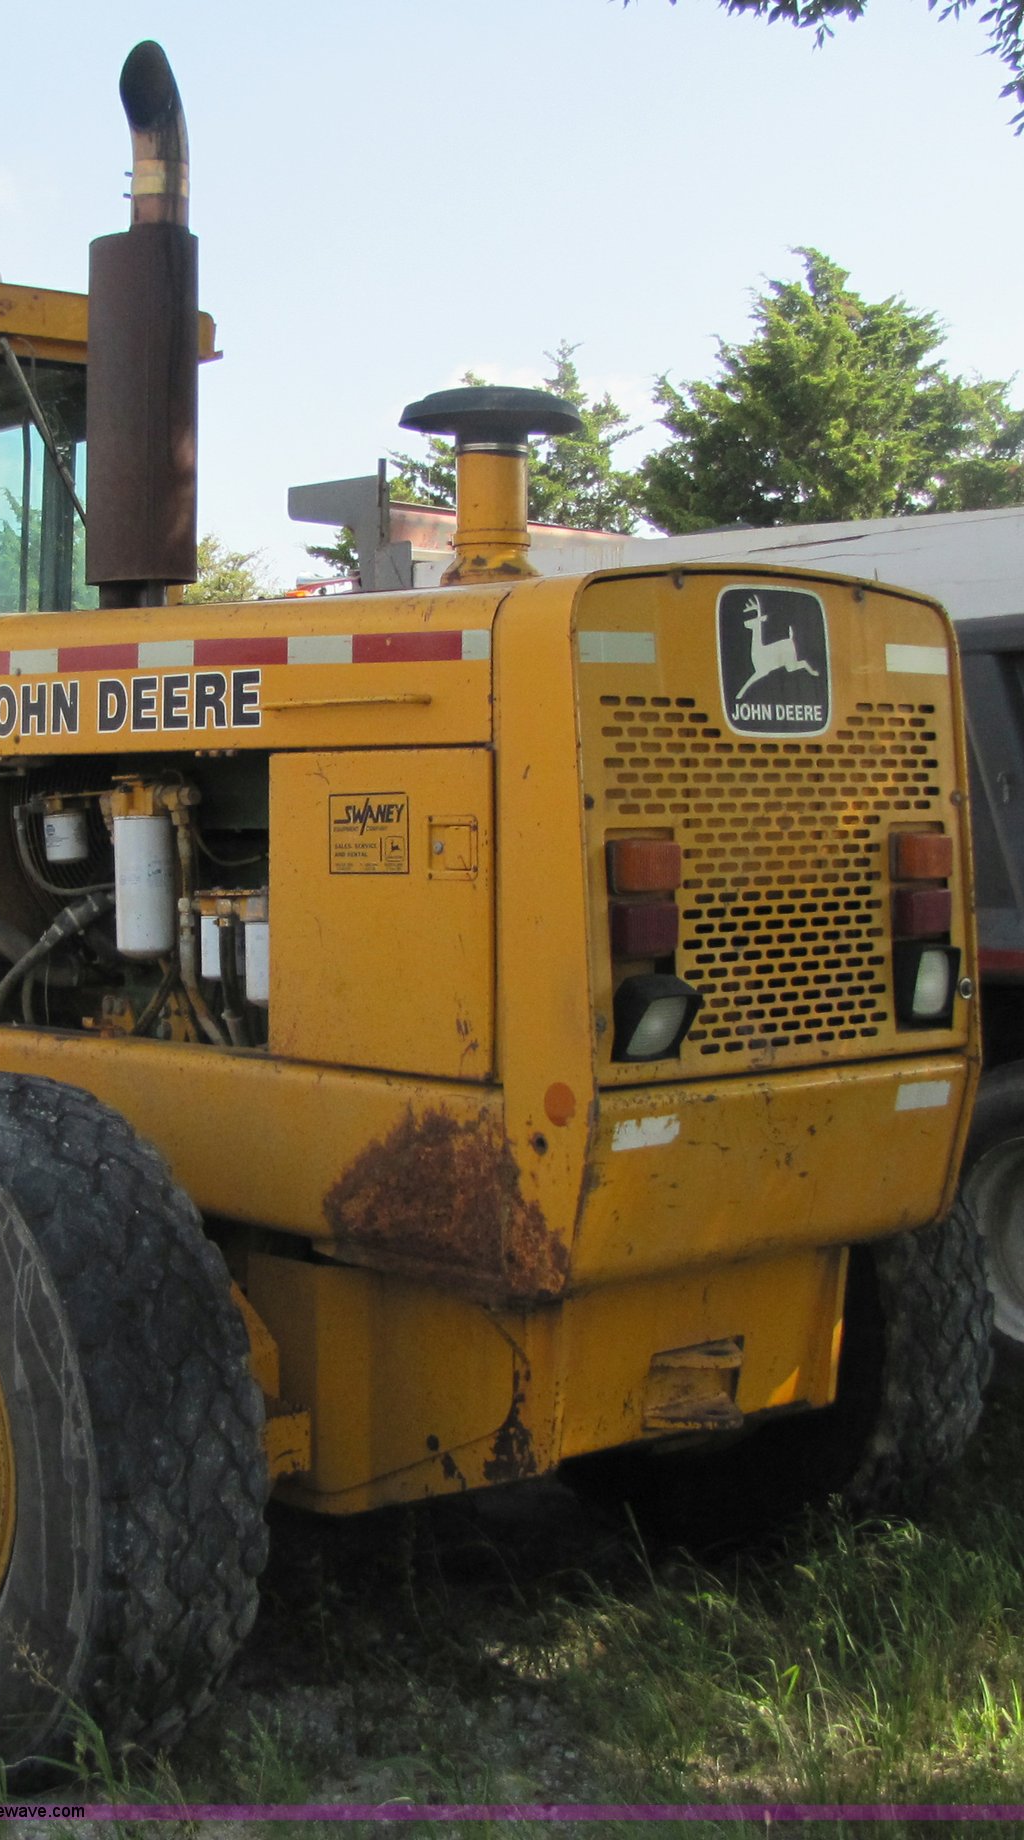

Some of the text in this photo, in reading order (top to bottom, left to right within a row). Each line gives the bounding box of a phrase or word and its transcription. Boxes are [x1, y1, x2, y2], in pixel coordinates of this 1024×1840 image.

[97, 668, 262, 733] DEERE
[732, 703, 823, 722] JOHN DEERE
[334, 798, 405, 828] SWANEY
